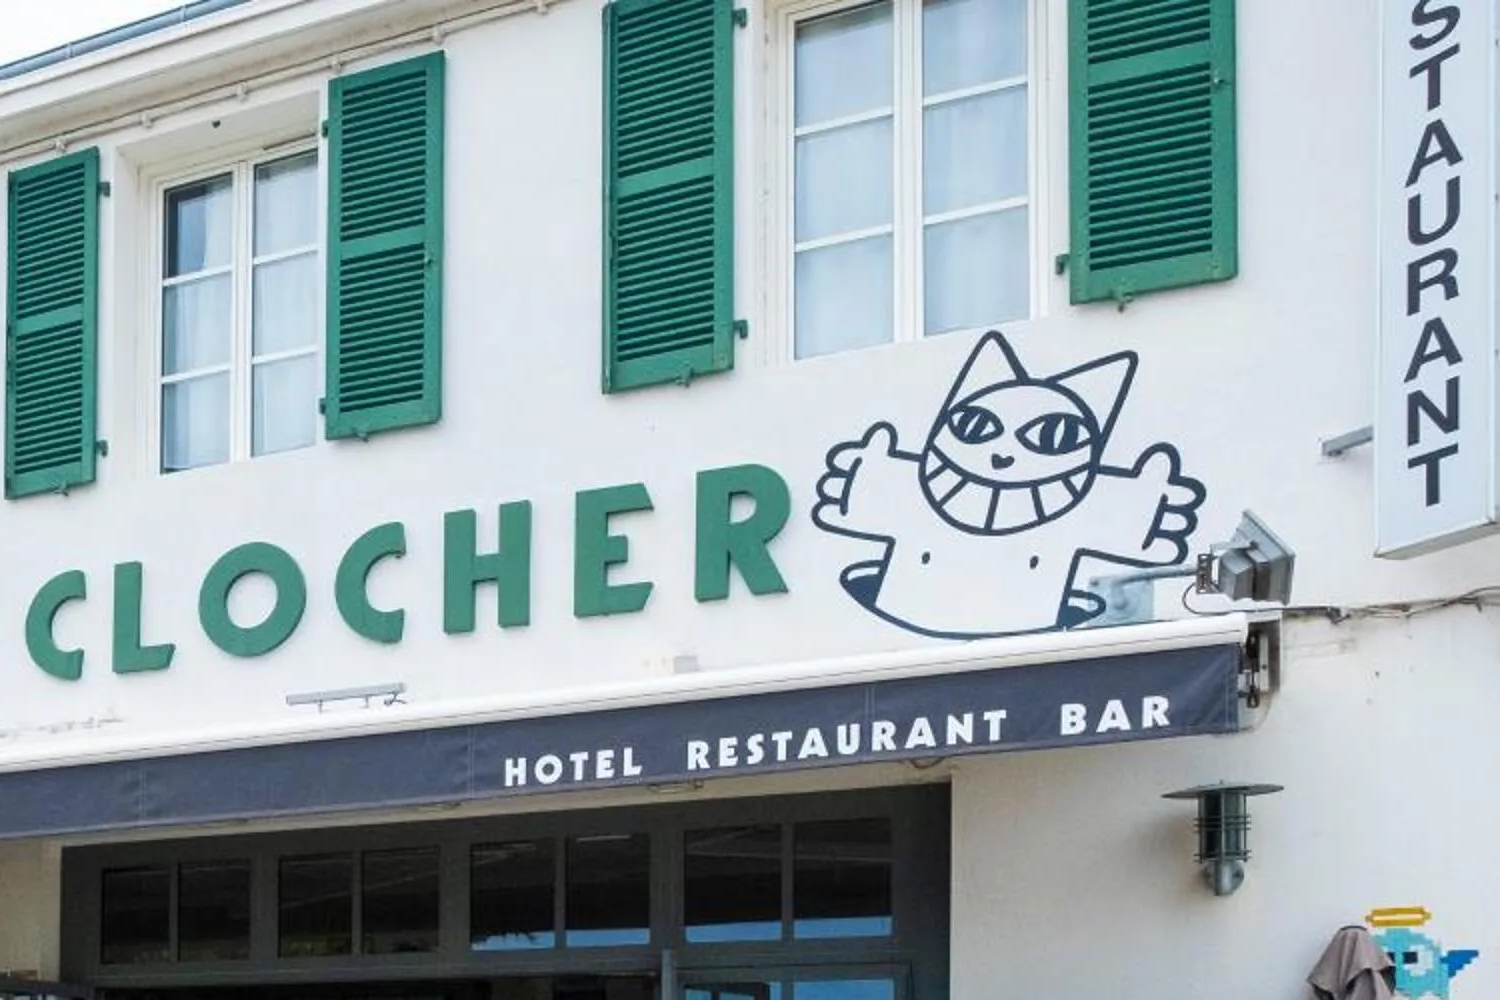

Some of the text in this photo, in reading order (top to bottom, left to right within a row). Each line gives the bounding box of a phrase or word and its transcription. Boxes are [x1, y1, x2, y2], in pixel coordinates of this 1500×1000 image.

[24, 463, 792, 682] CLOCHER
[503, 695, 1171, 787] HOTEL RESTAURANT BAR
